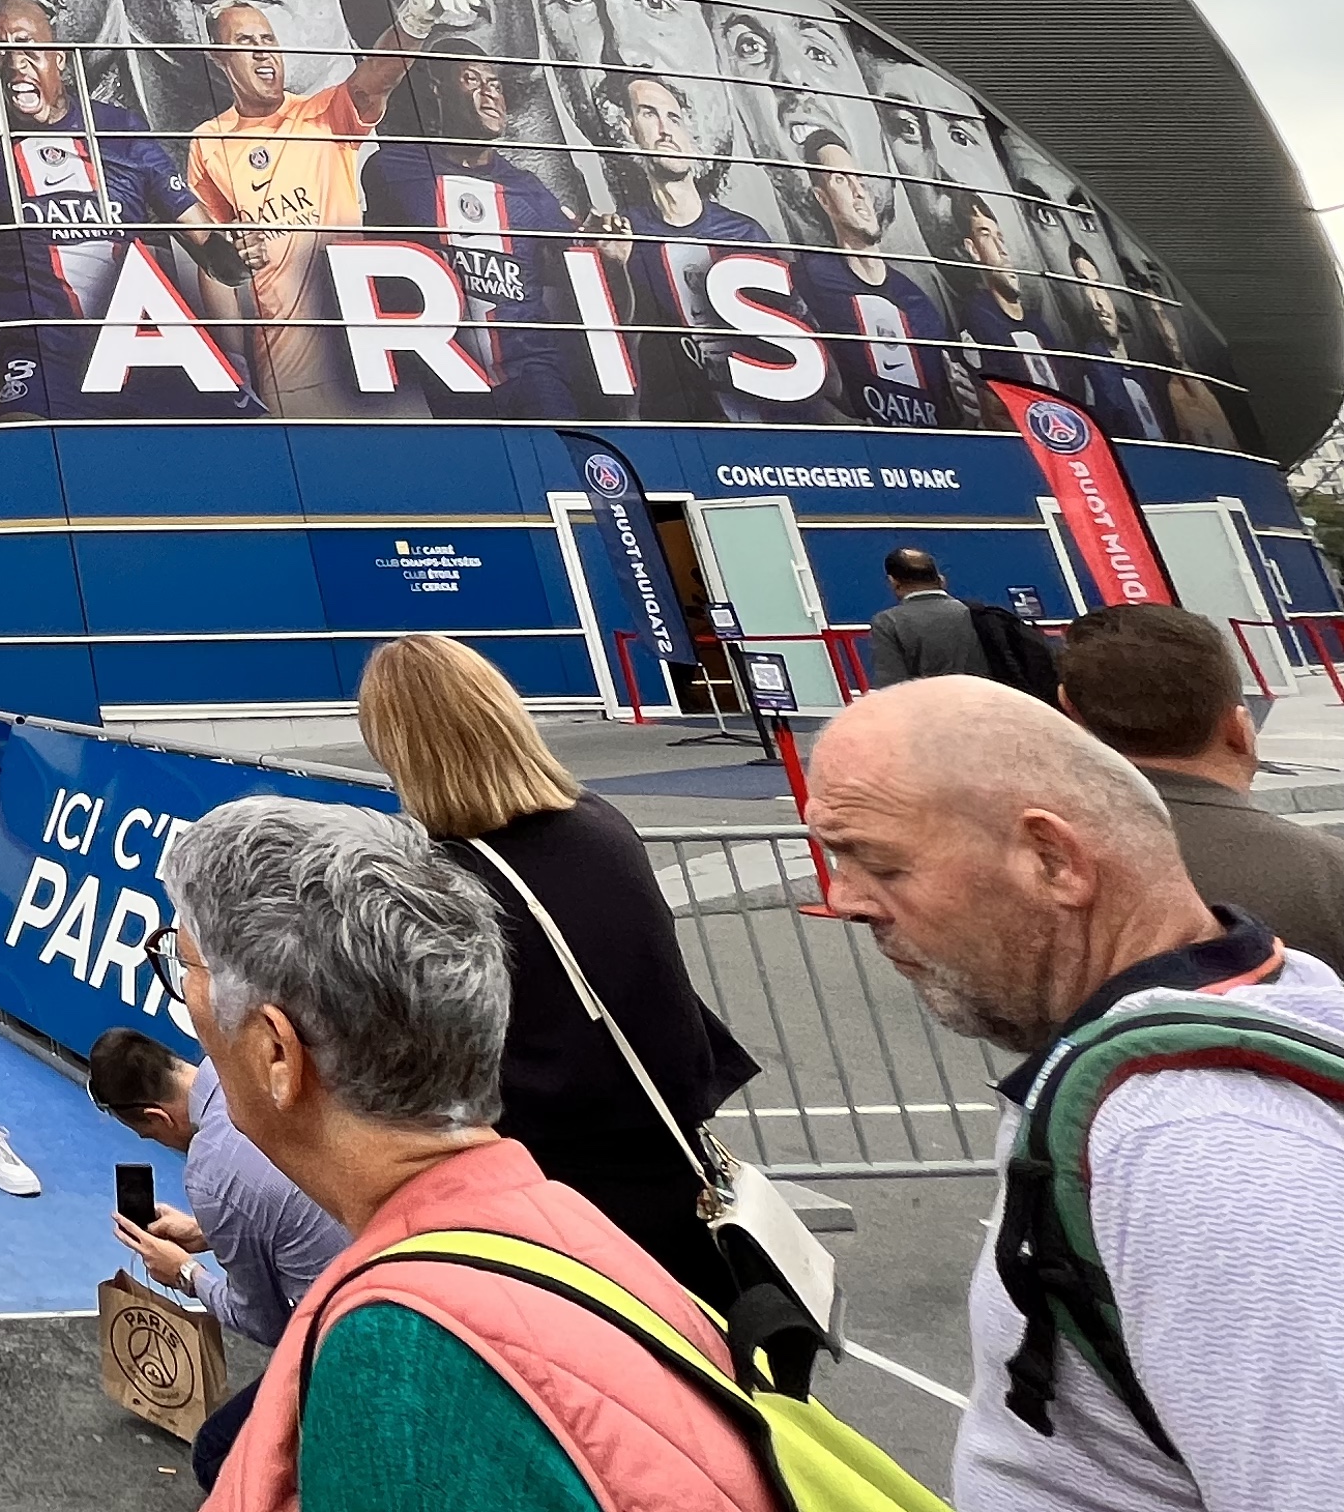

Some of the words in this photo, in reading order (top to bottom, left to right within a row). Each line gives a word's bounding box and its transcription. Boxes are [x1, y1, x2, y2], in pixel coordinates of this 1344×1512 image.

[450, 251, 521, 287] ATAR
[463, 274, 523, 301] IRWAYS
[863, 385, 938, 426] QATAR
[717, 464, 874, 488] CONCIERGERIE
[882, 469, 907, 489] DU
[911, 469, 960, 490] PARC
[43, 788, 104, 855] ICI
[124, 1311, 180, 1349] PARIS
